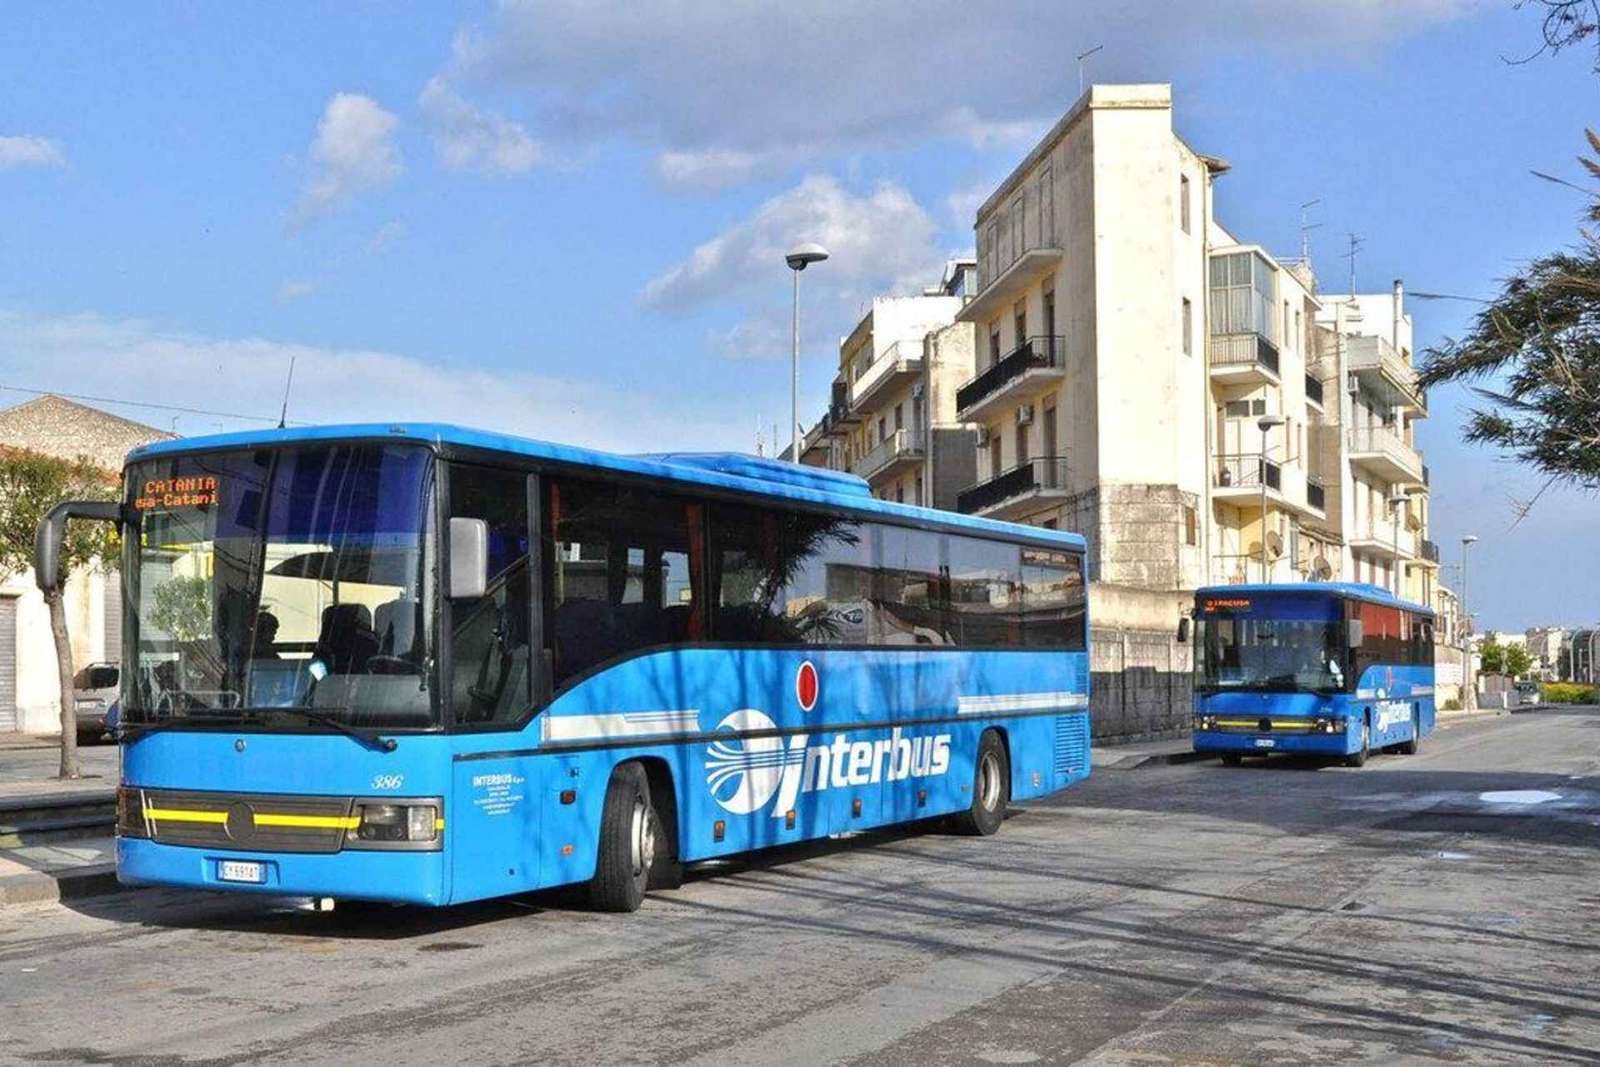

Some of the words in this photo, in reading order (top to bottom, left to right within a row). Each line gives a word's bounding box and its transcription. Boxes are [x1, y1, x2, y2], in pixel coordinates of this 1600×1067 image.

[145, 477, 215, 494] CATANIA
[371, 774, 404, 790] 386
[472, 774, 512, 787] INTERBUS
